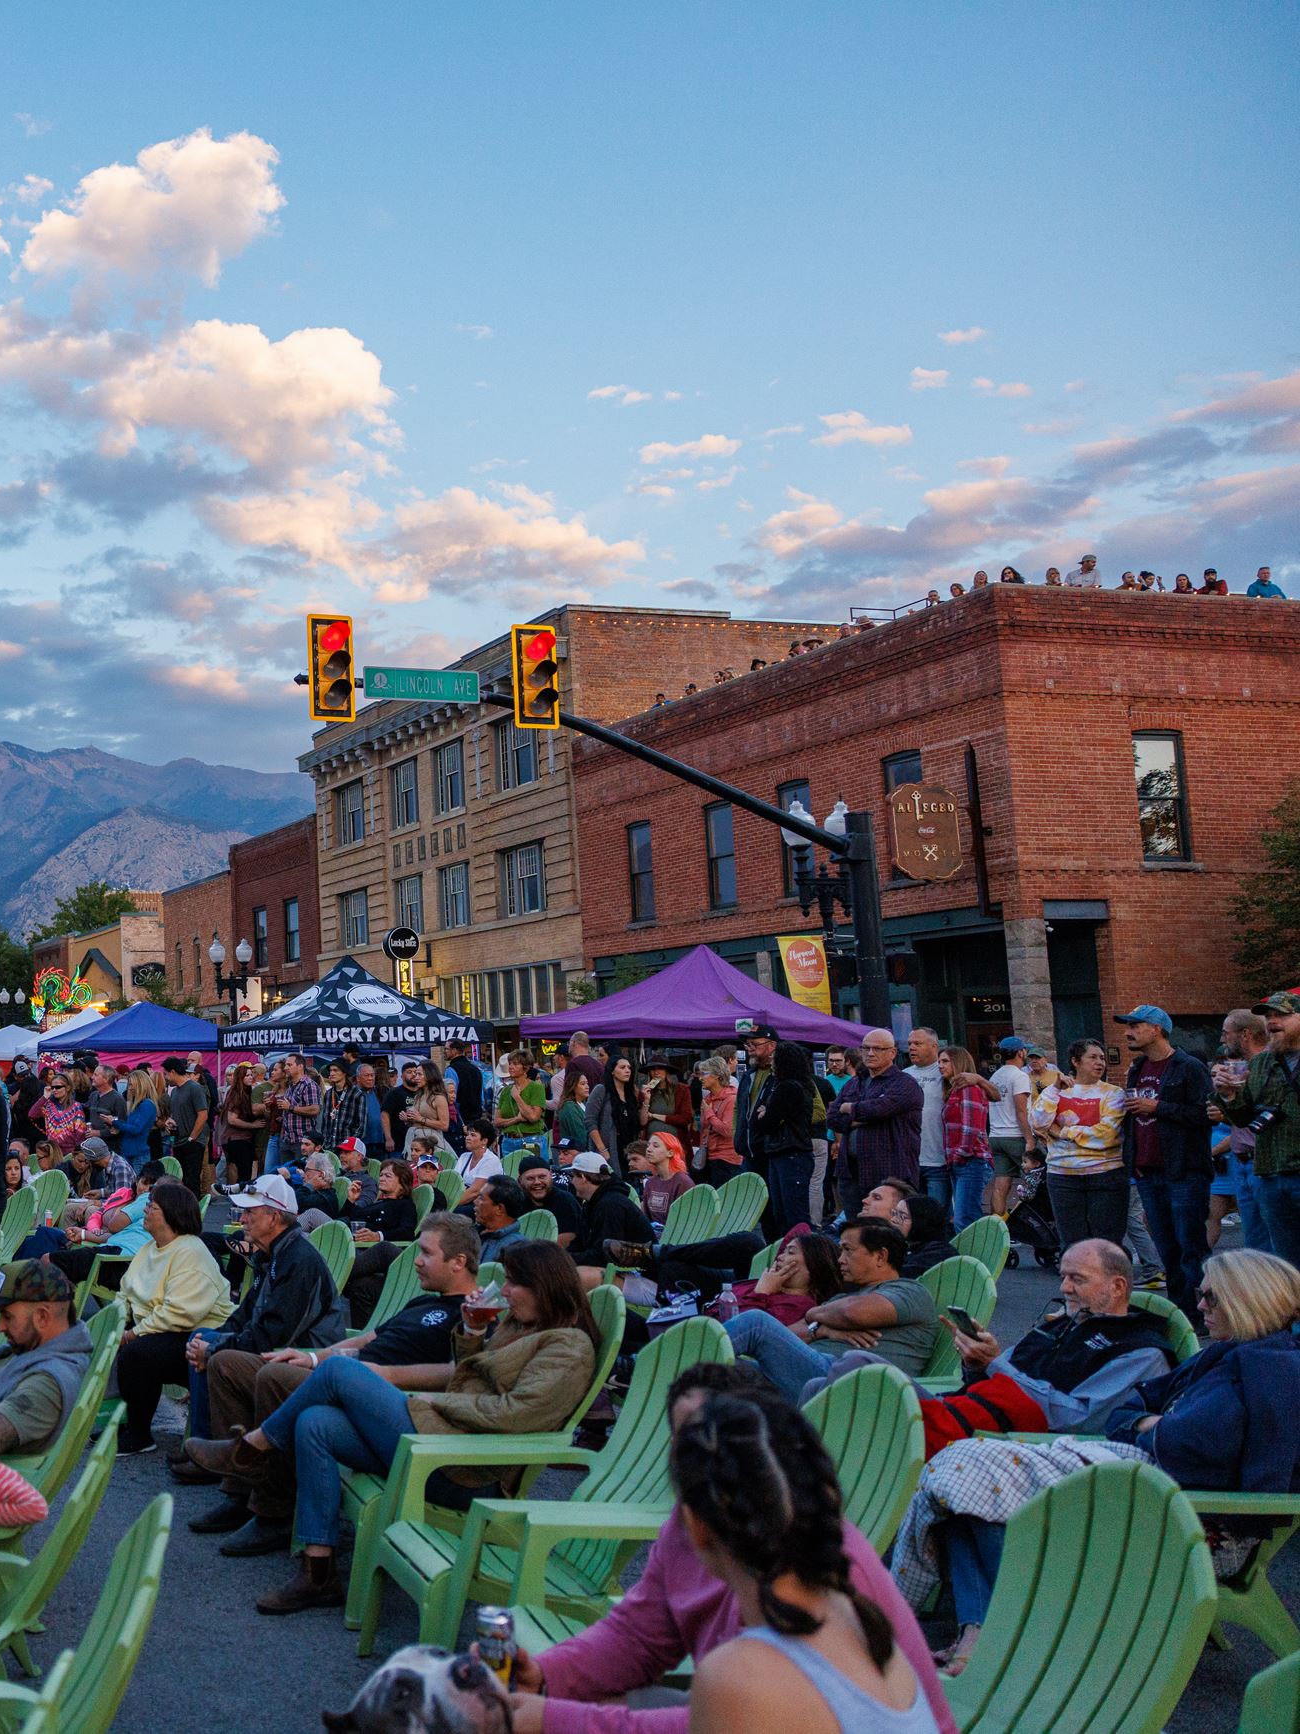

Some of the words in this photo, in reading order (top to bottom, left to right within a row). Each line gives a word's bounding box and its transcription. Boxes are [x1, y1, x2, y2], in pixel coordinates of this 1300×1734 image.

[399, 675, 444, 695] LINCOLN
[453, 679, 476, 697] AVE.
[983, 1003, 1006, 1013] 201
[223, 1030, 248, 1048] LUCKY
[248, 1029, 268, 1046] SLICE
[269, 1028, 294, 1045] PIZZA
[316, 1026, 376, 1043] LUCKY
[380, 1026, 426, 1042] SLICE
[429, 1026, 479, 1042] PIZZA
